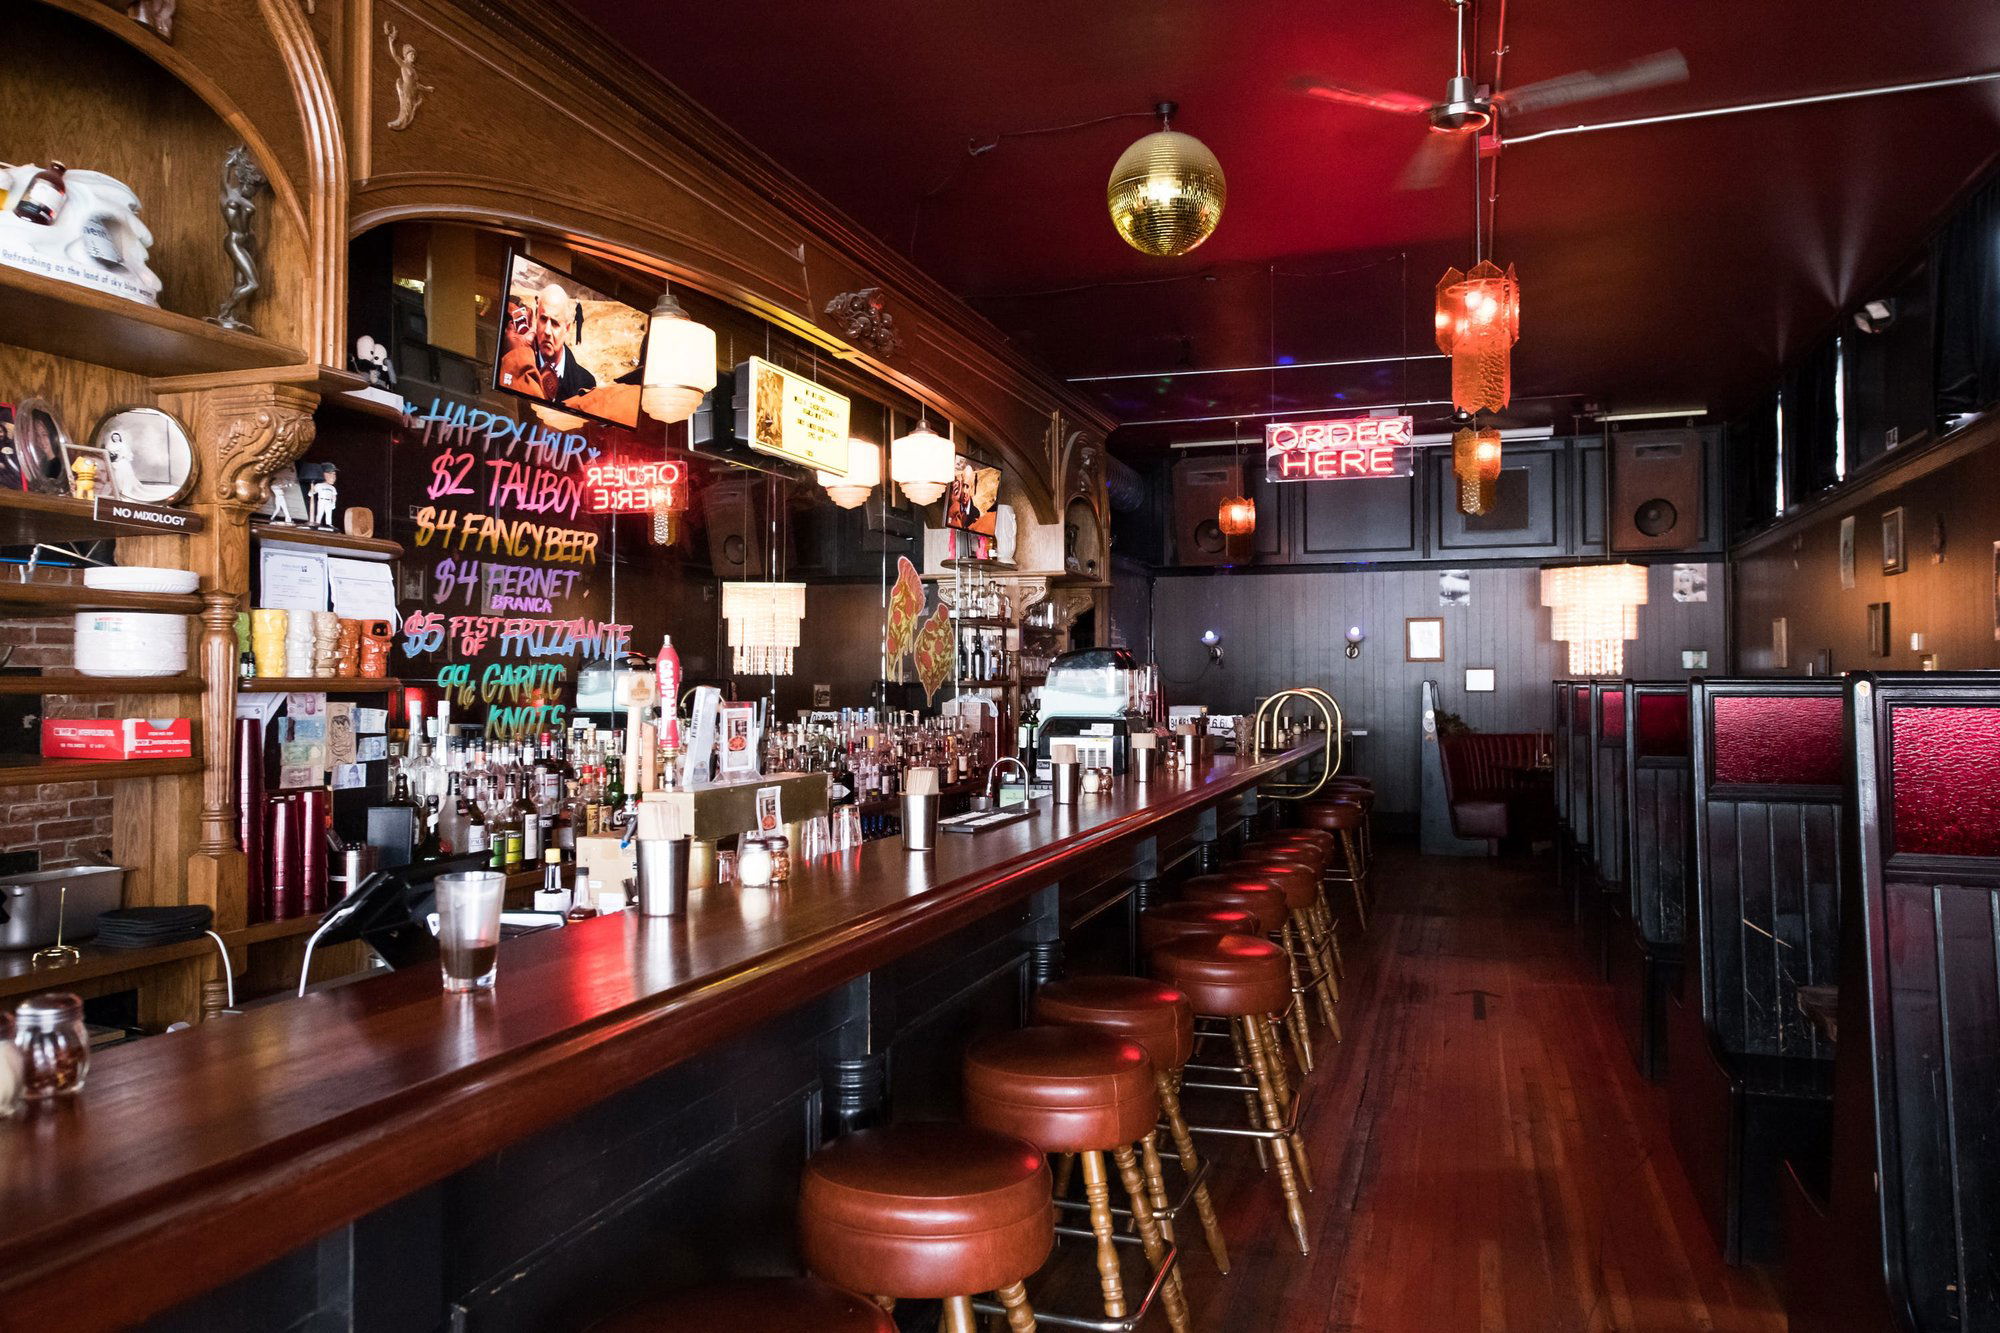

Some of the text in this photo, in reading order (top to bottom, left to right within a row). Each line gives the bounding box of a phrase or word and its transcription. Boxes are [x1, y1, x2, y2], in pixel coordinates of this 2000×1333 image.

[420, 398, 585, 472] HAPPY HOUR
[1272, 419, 1411, 450] ORDER
[1283, 448, 1394, 476] HERE
[427, 448, 584, 521] $2 TALLBOY
[113, 507, 186, 526] NO MIXOLOGY
[415, 506, 458, 548] $4
[433, 558, 479, 606] $4
[487, 562, 580, 600] FERNET
[491, 595, 552, 613] BRANCA
[402, 609, 633, 661] $5 FIST OF FRIZZANTE
[486, 704, 567, 740] KNOTS
